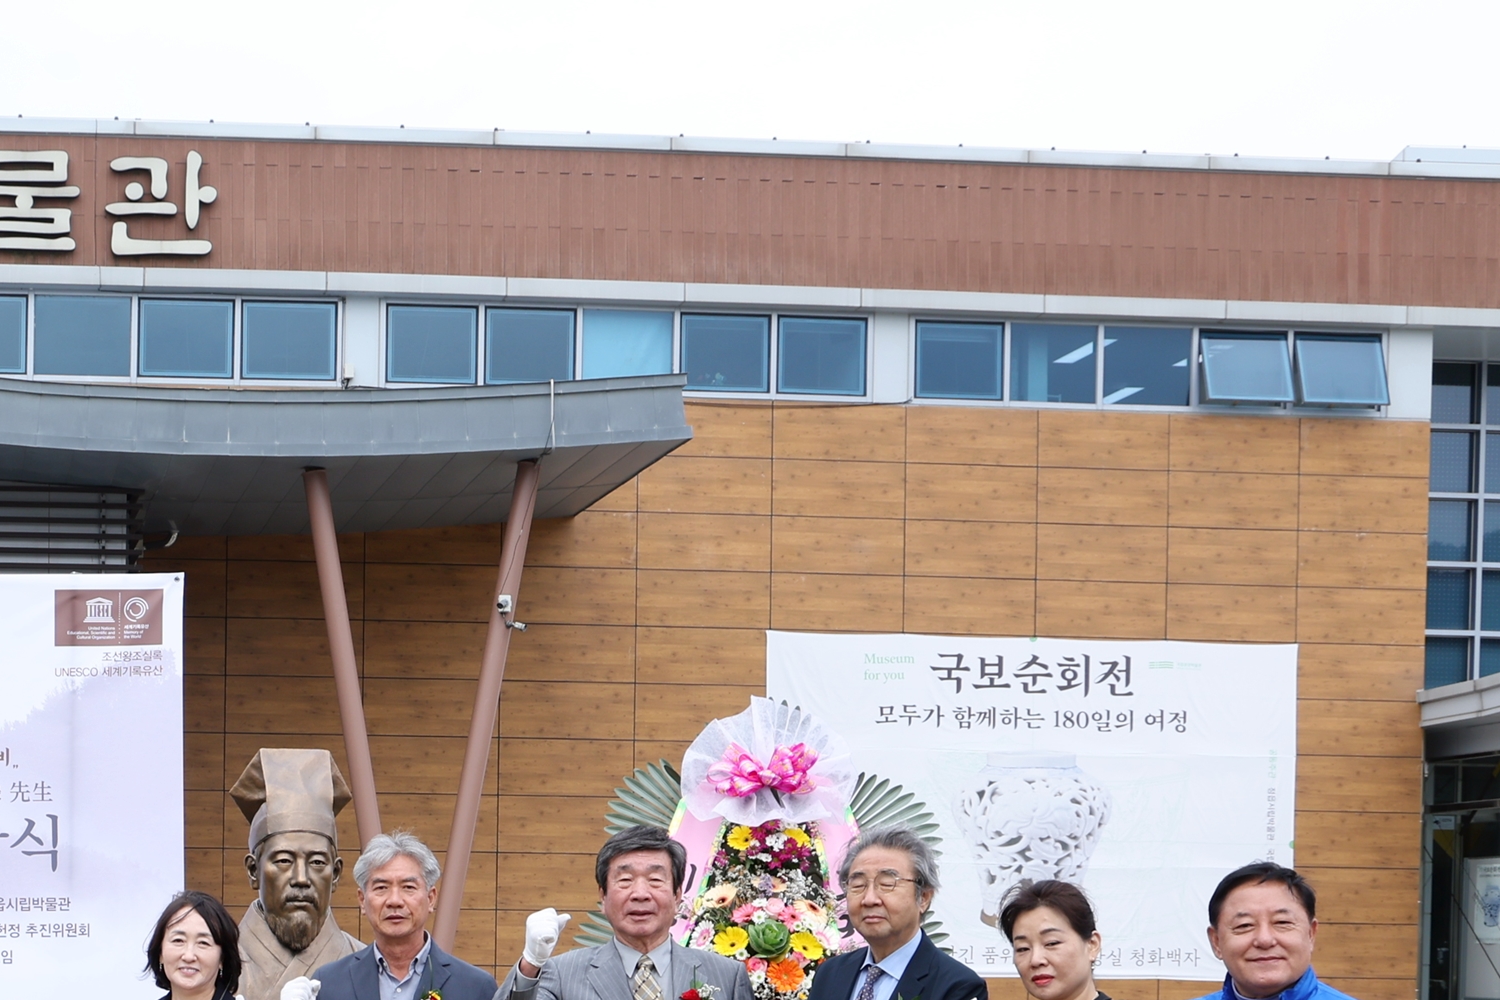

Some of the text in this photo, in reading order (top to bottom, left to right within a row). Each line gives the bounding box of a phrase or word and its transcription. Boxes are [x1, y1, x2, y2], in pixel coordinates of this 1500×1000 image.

[102, 650, 162, 662] 조선왕조실록
[864, 653, 915, 664] Museum
[54, 666, 162, 677] UNESCO 세계기록유산
[864, 669, 905, 684] for you
[930, 652, 1134, 697] 국보순회전
[875, 706, 1188, 734] 모두가 함께하는 180일의 여정
[10, 781, 53, 803] 先生
[26, 923, 91, 938] 추진위원회
[1130, 948, 1200, 967] 청화백자
